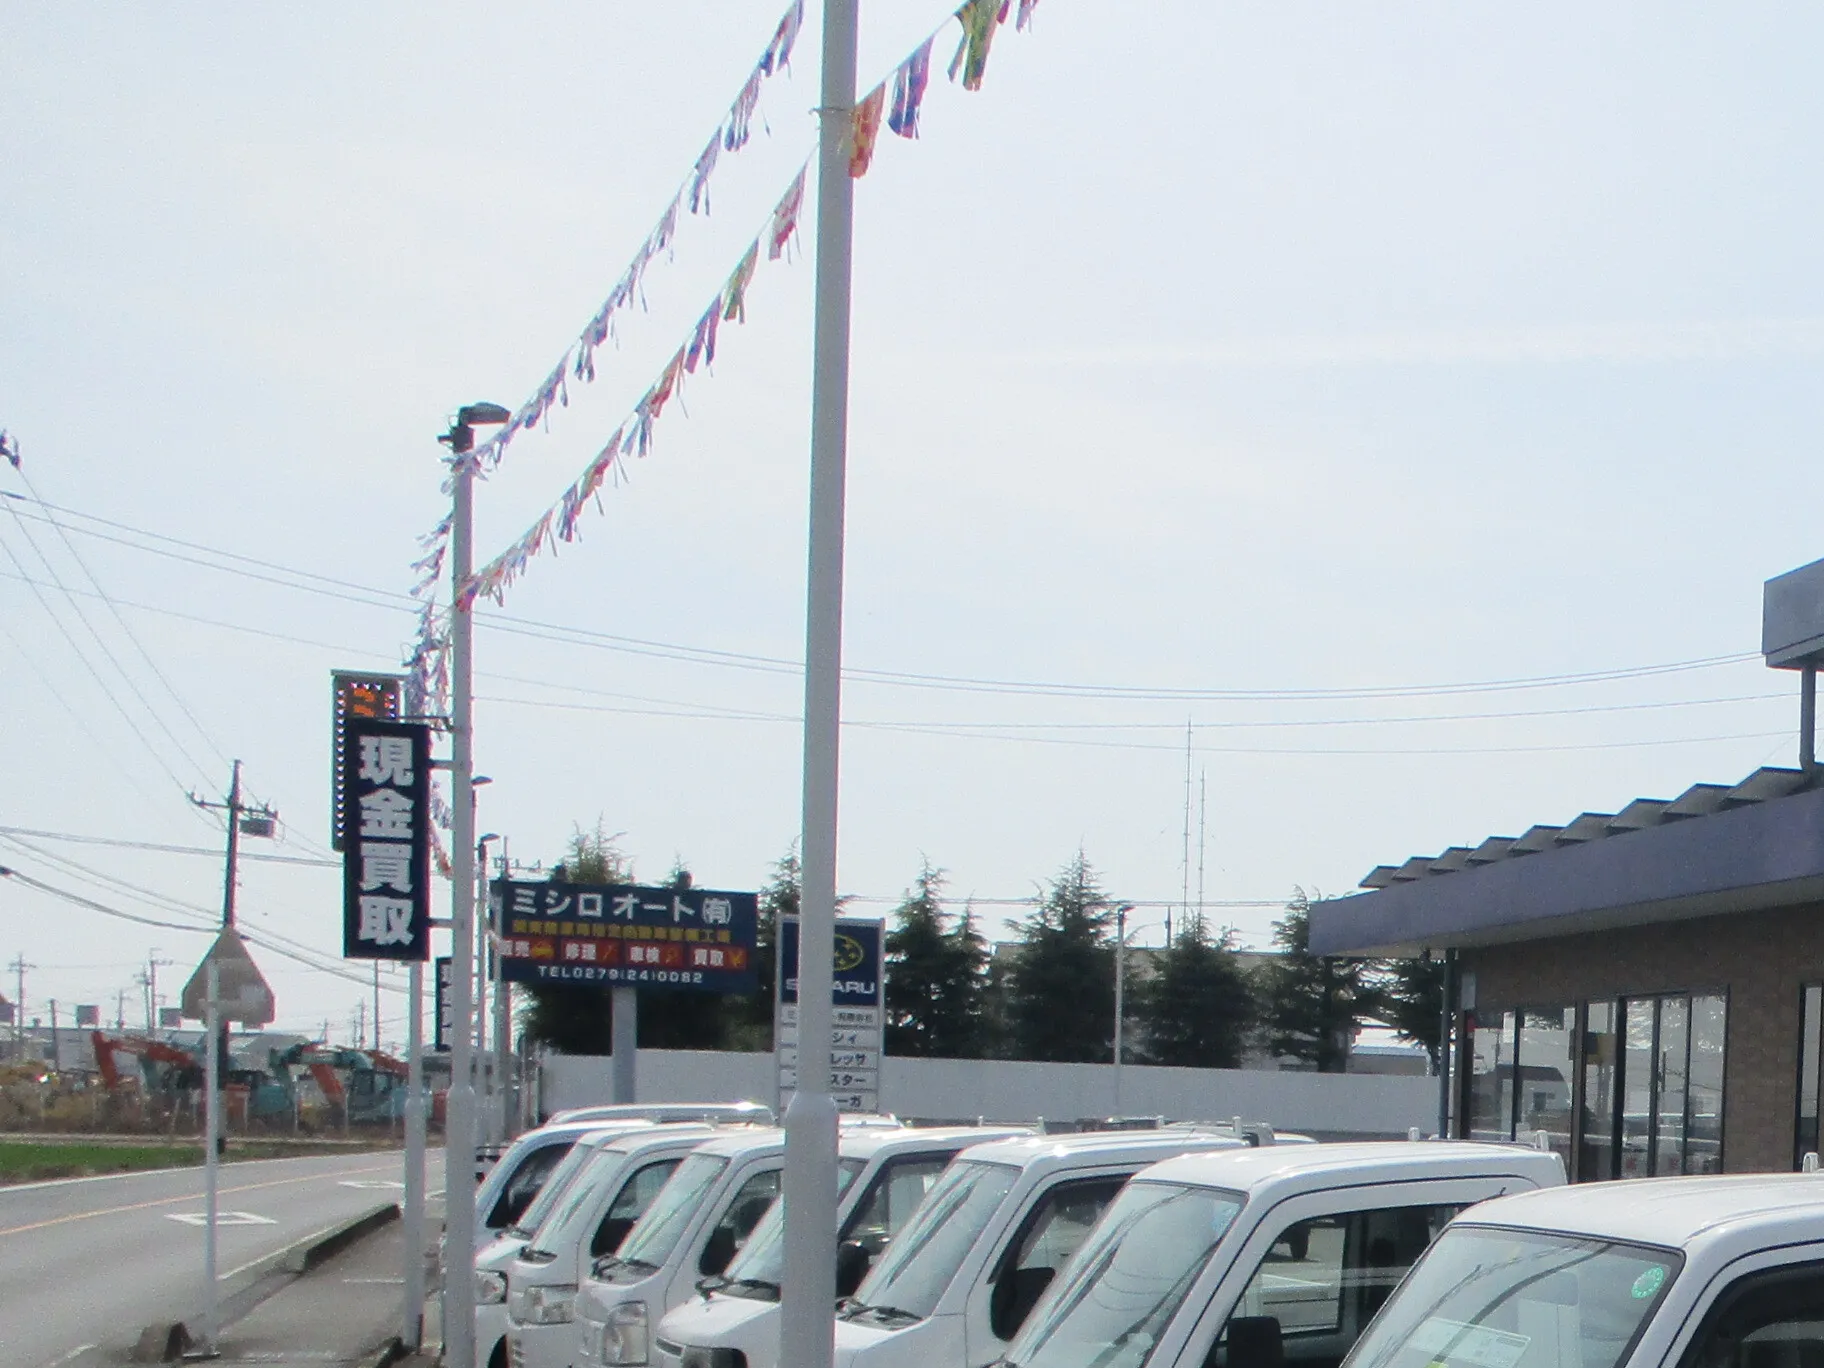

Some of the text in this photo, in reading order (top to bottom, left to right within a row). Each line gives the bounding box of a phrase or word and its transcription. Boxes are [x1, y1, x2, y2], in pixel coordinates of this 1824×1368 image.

[357, 735, 414, 948] 現金買取
[785, 977, 876, 996] SARU
